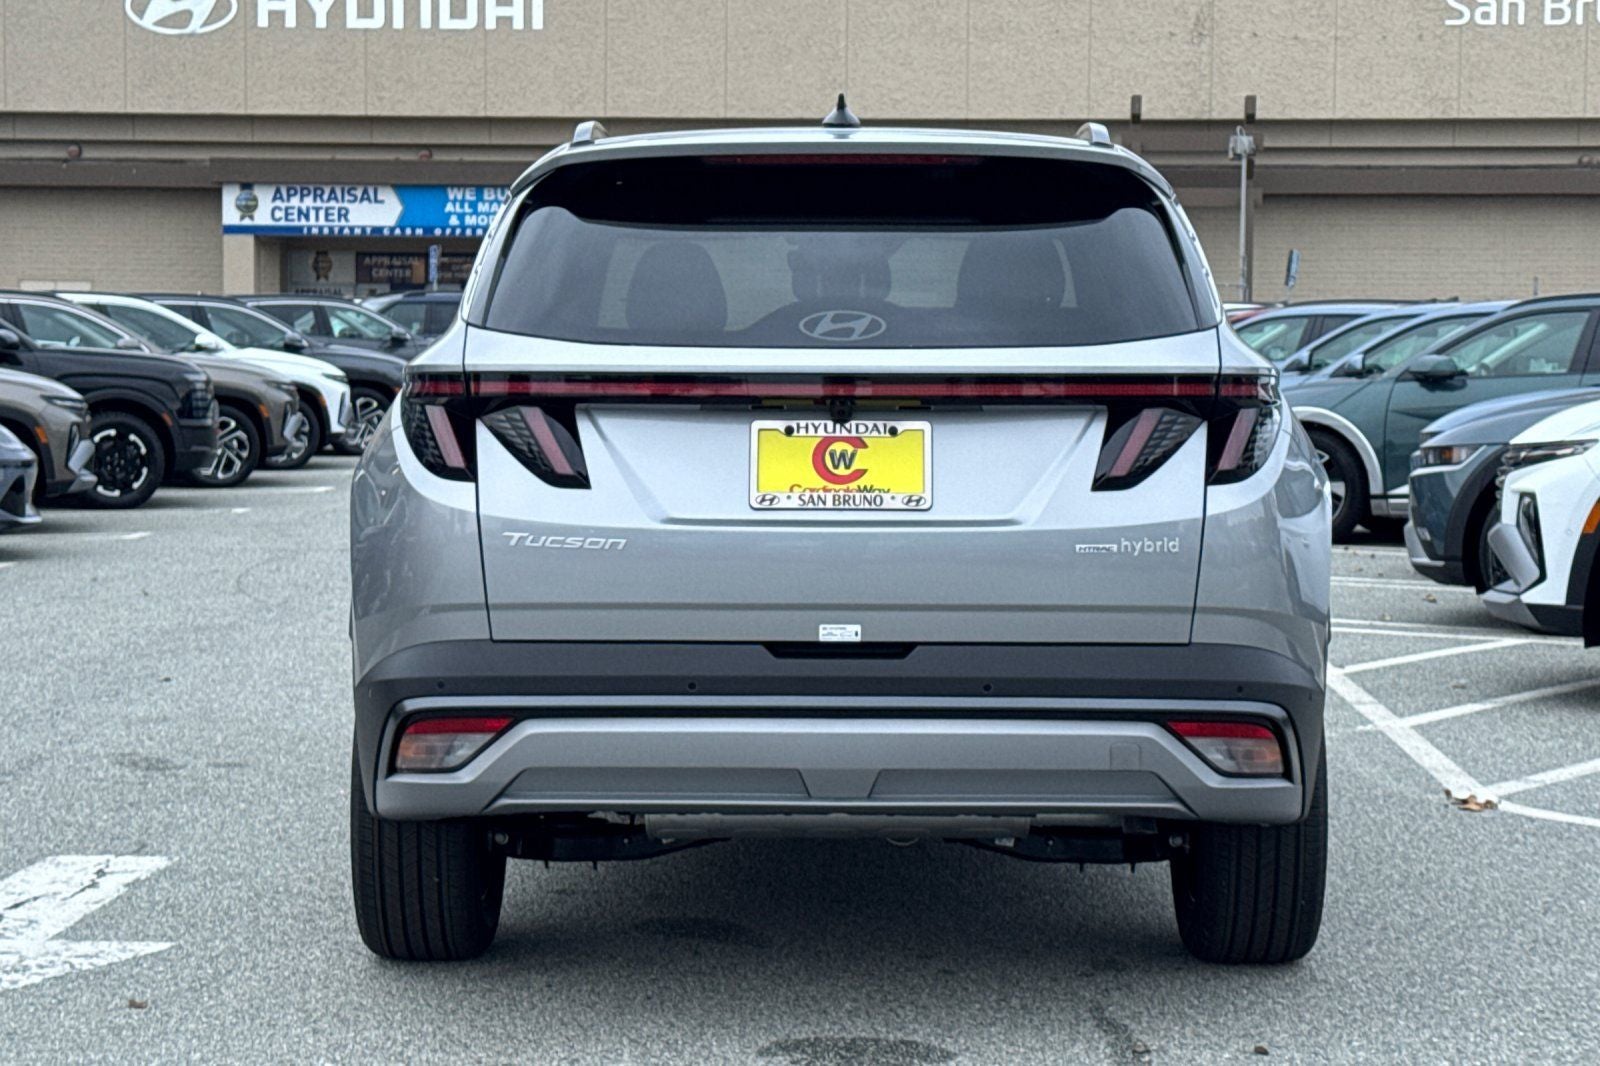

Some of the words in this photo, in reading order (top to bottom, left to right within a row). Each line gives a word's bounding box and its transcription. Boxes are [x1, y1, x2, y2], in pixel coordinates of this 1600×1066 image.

[1444, 0, 1526, 26] San
[1543, 0, 1600, 26] Br
[271, 186, 385, 204] APPRAISAL
[447, 187, 476, 201] WE
[444, 201, 473, 213] ALL
[270, 206, 350, 223] CENTER
[448, 214, 460, 226] &
[382, 227, 424, 236] CASH
[796, 423, 888, 434] HYUNDAI
[798, 494, 828, 507] SAN
[832, 494, 884, 507] BRUNO
[1121, 536, 1180, 556] hybrid
